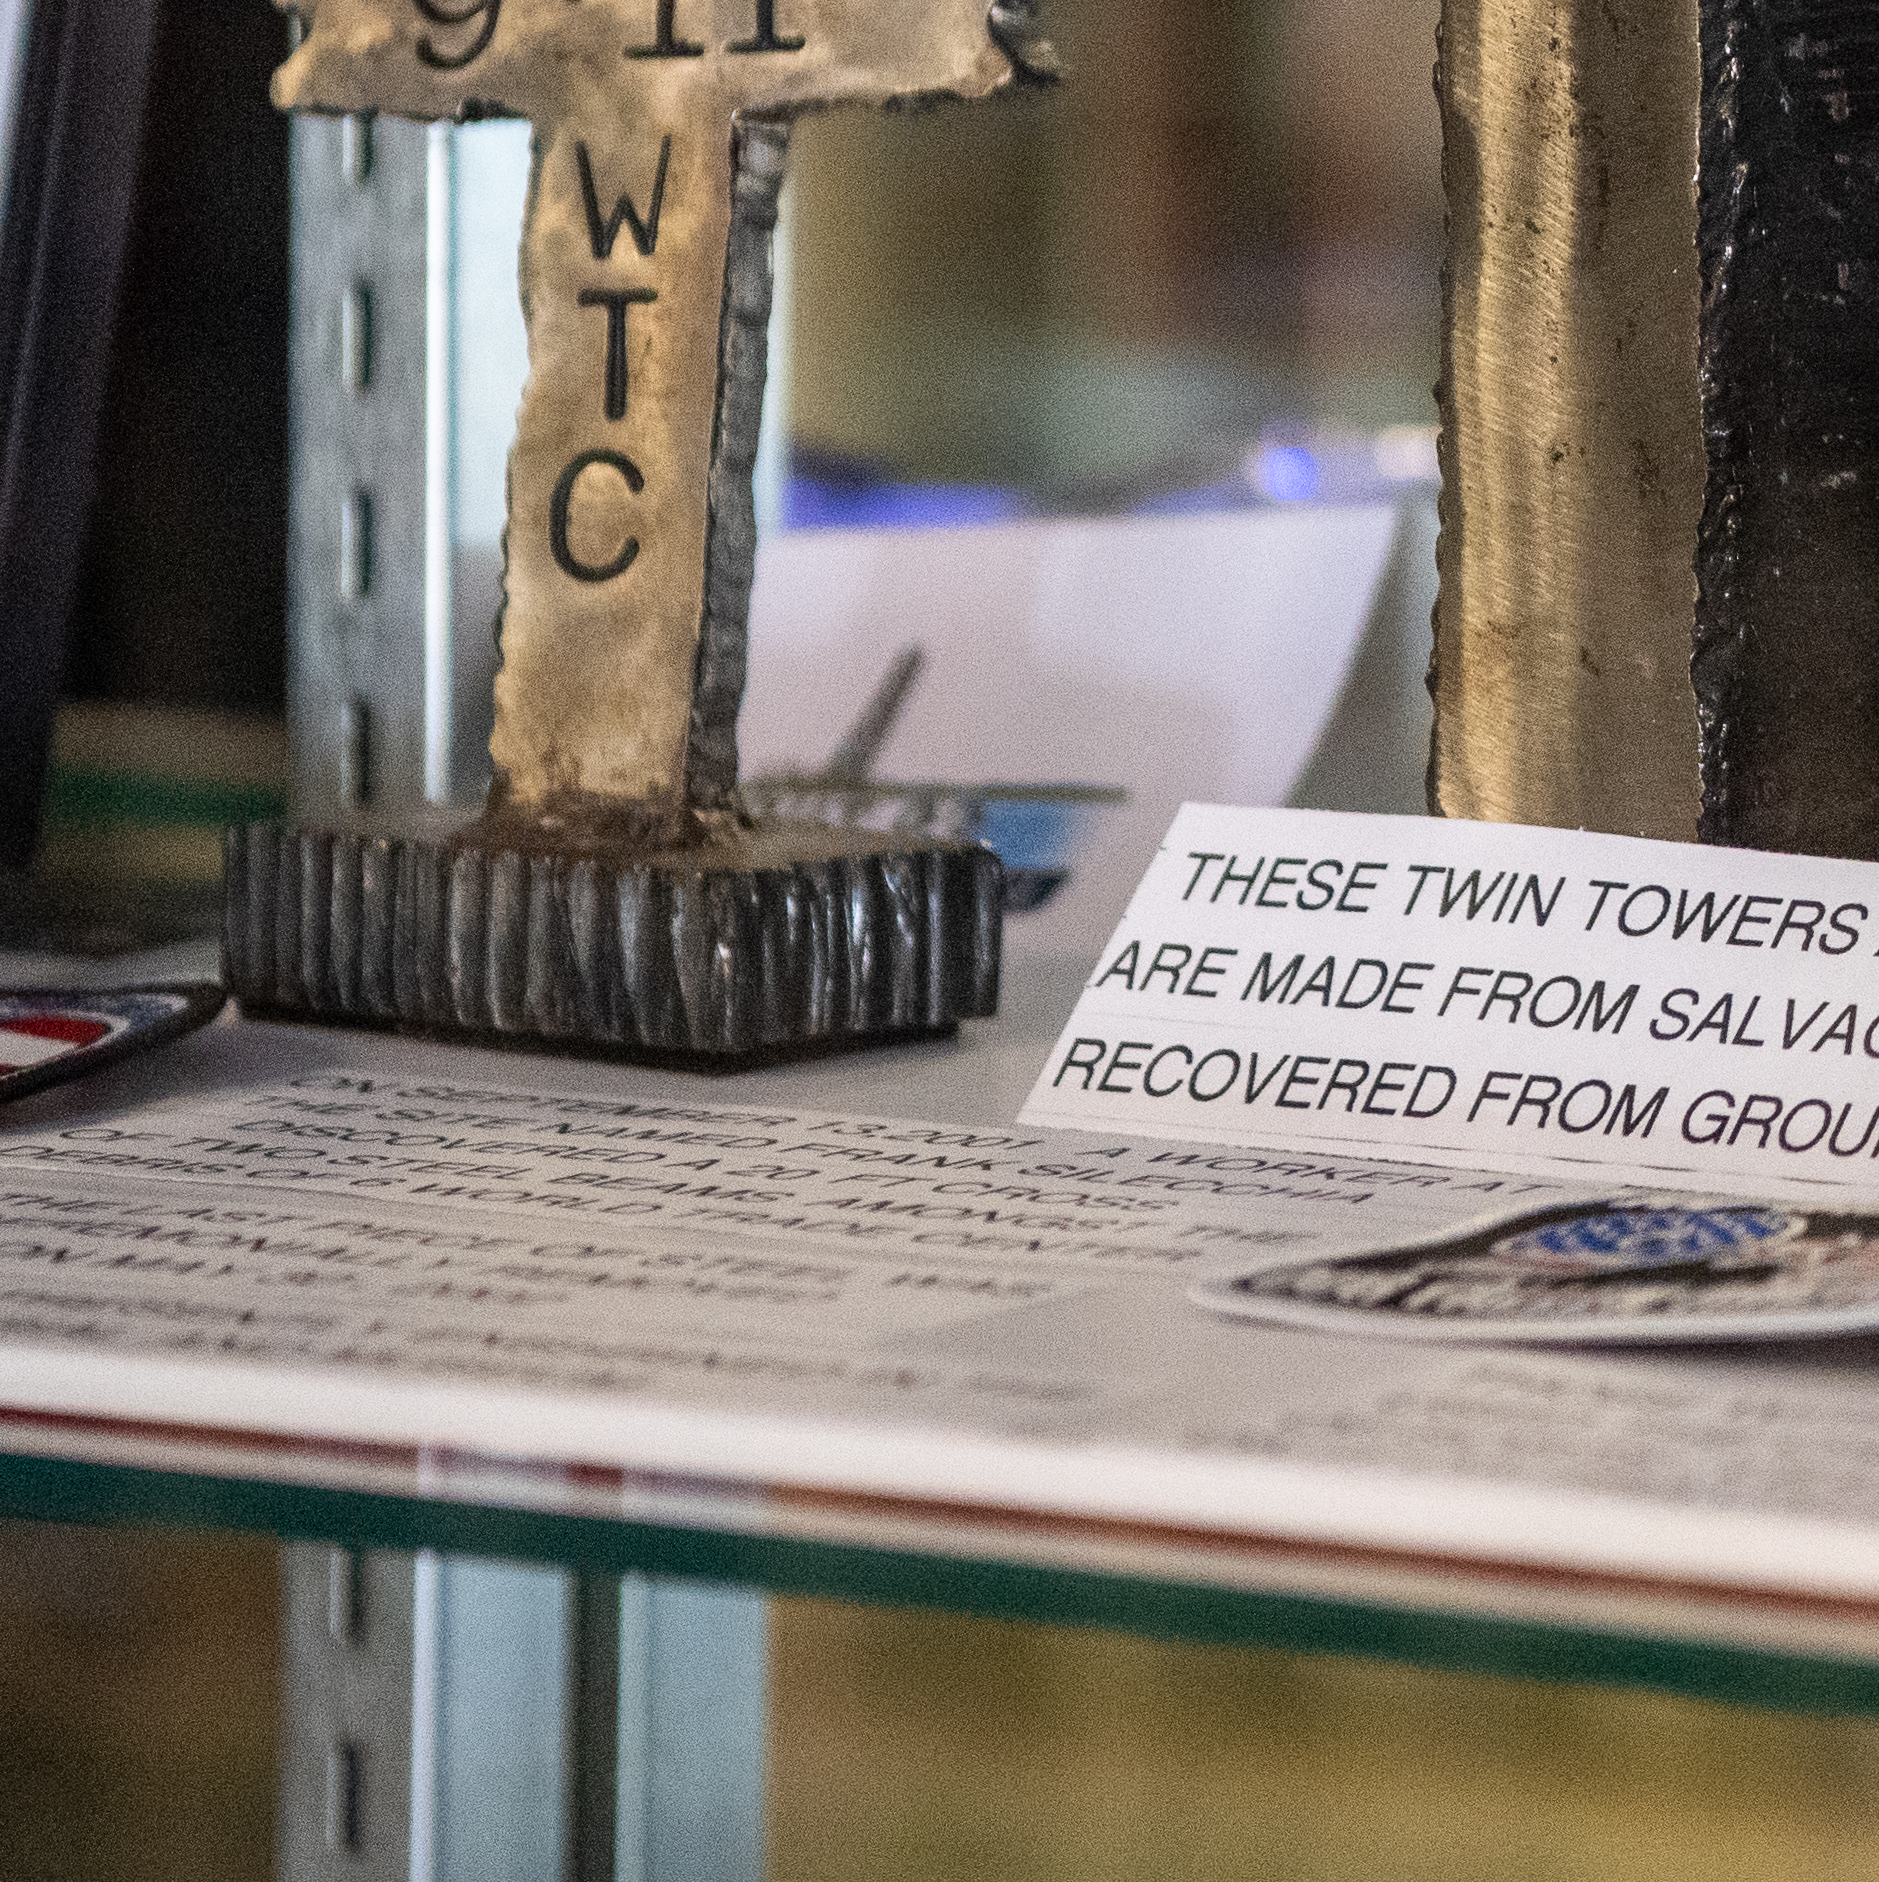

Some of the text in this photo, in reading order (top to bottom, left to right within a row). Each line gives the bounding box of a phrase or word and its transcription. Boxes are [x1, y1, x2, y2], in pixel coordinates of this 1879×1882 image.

[1182, 853, 1387, 913] THESE
[1403, 865, 1565, 926] TWIN
[1584, 880, 1869, 955] TOWERS
[1097, 942, 1237, 998] ARE
[1242, 952, 1434, 1014] MADE
[1439, 967, 1640, 1034] FROM
[1054, 1038, 1457, 1119] RECOVERED
[1467, 1071, 1669, 1138] FROM
[528, 1122, 778, 1149] NAMED
[778, 1141, 1020, 1172] FRANK
[1074, 1146, 1131, 1160] A
[1145, 1150, 1453, 1187] WORKER
[547, 1171, 796, 1204] BEAMS
[663, 1157, 722, 1172] A
[932, 1180, 1180, 1212] CROSS
